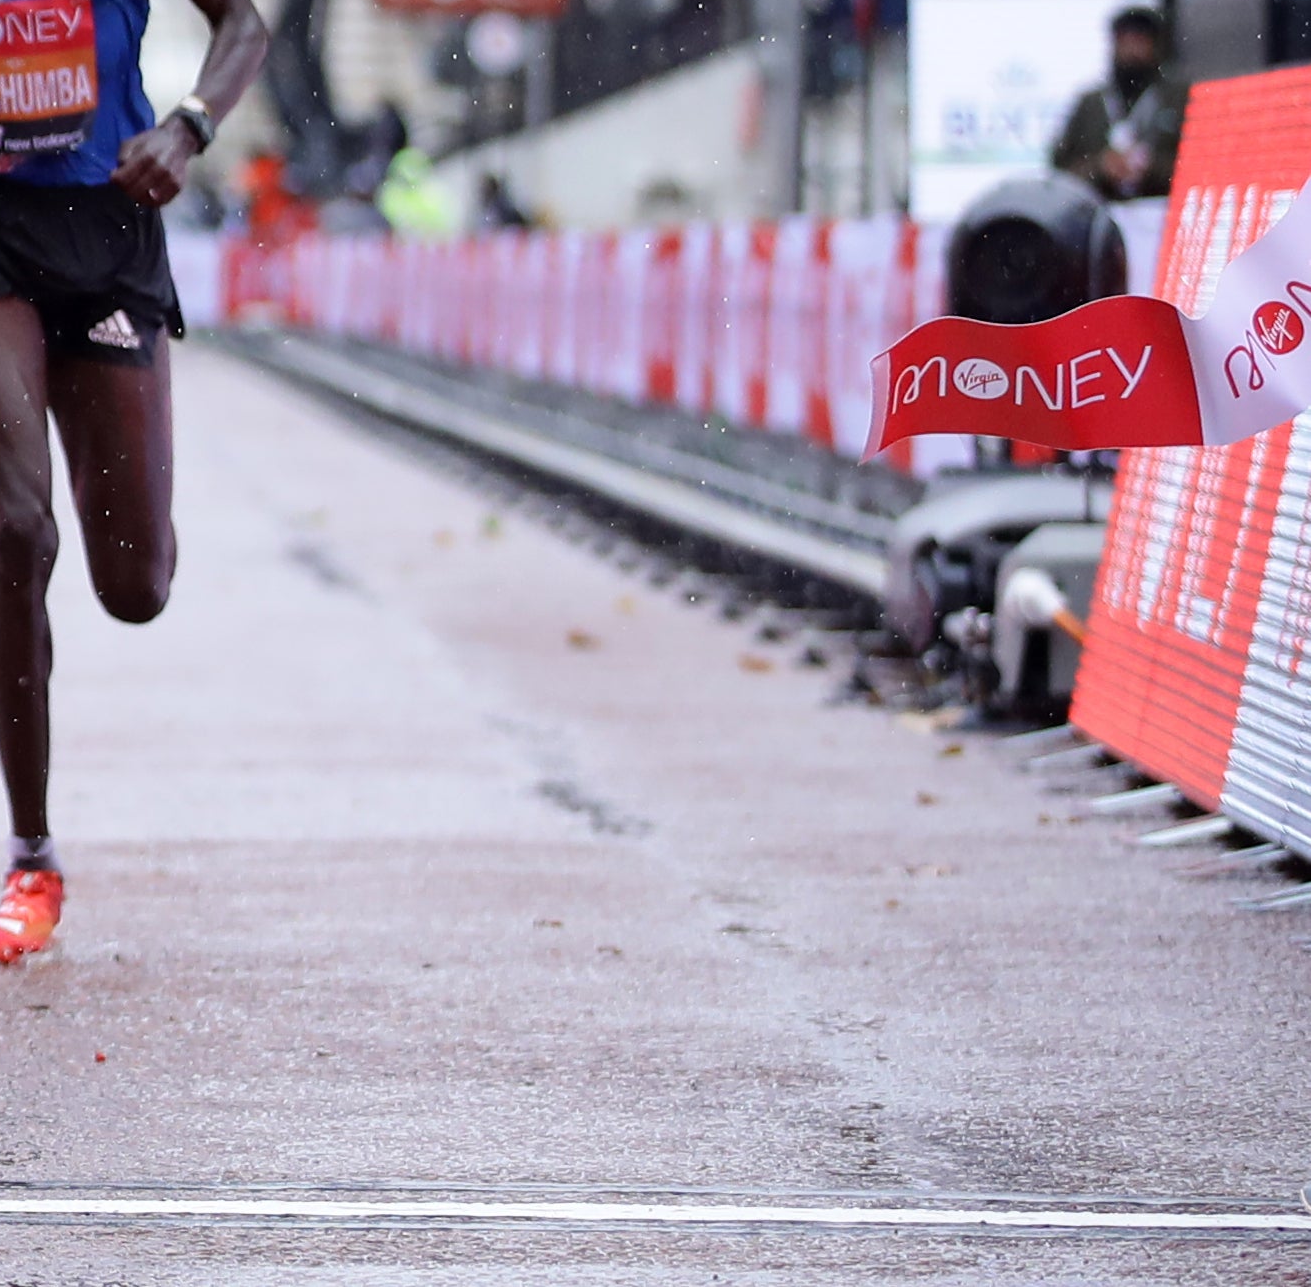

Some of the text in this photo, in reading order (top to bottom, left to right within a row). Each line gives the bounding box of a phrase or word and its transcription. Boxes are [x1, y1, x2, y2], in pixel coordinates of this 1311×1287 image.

[1257, 307, 1295, 350] Virgin
[892, 345, 1153, 415] MONEY
[958, 362, 1004, 393] Virgin
